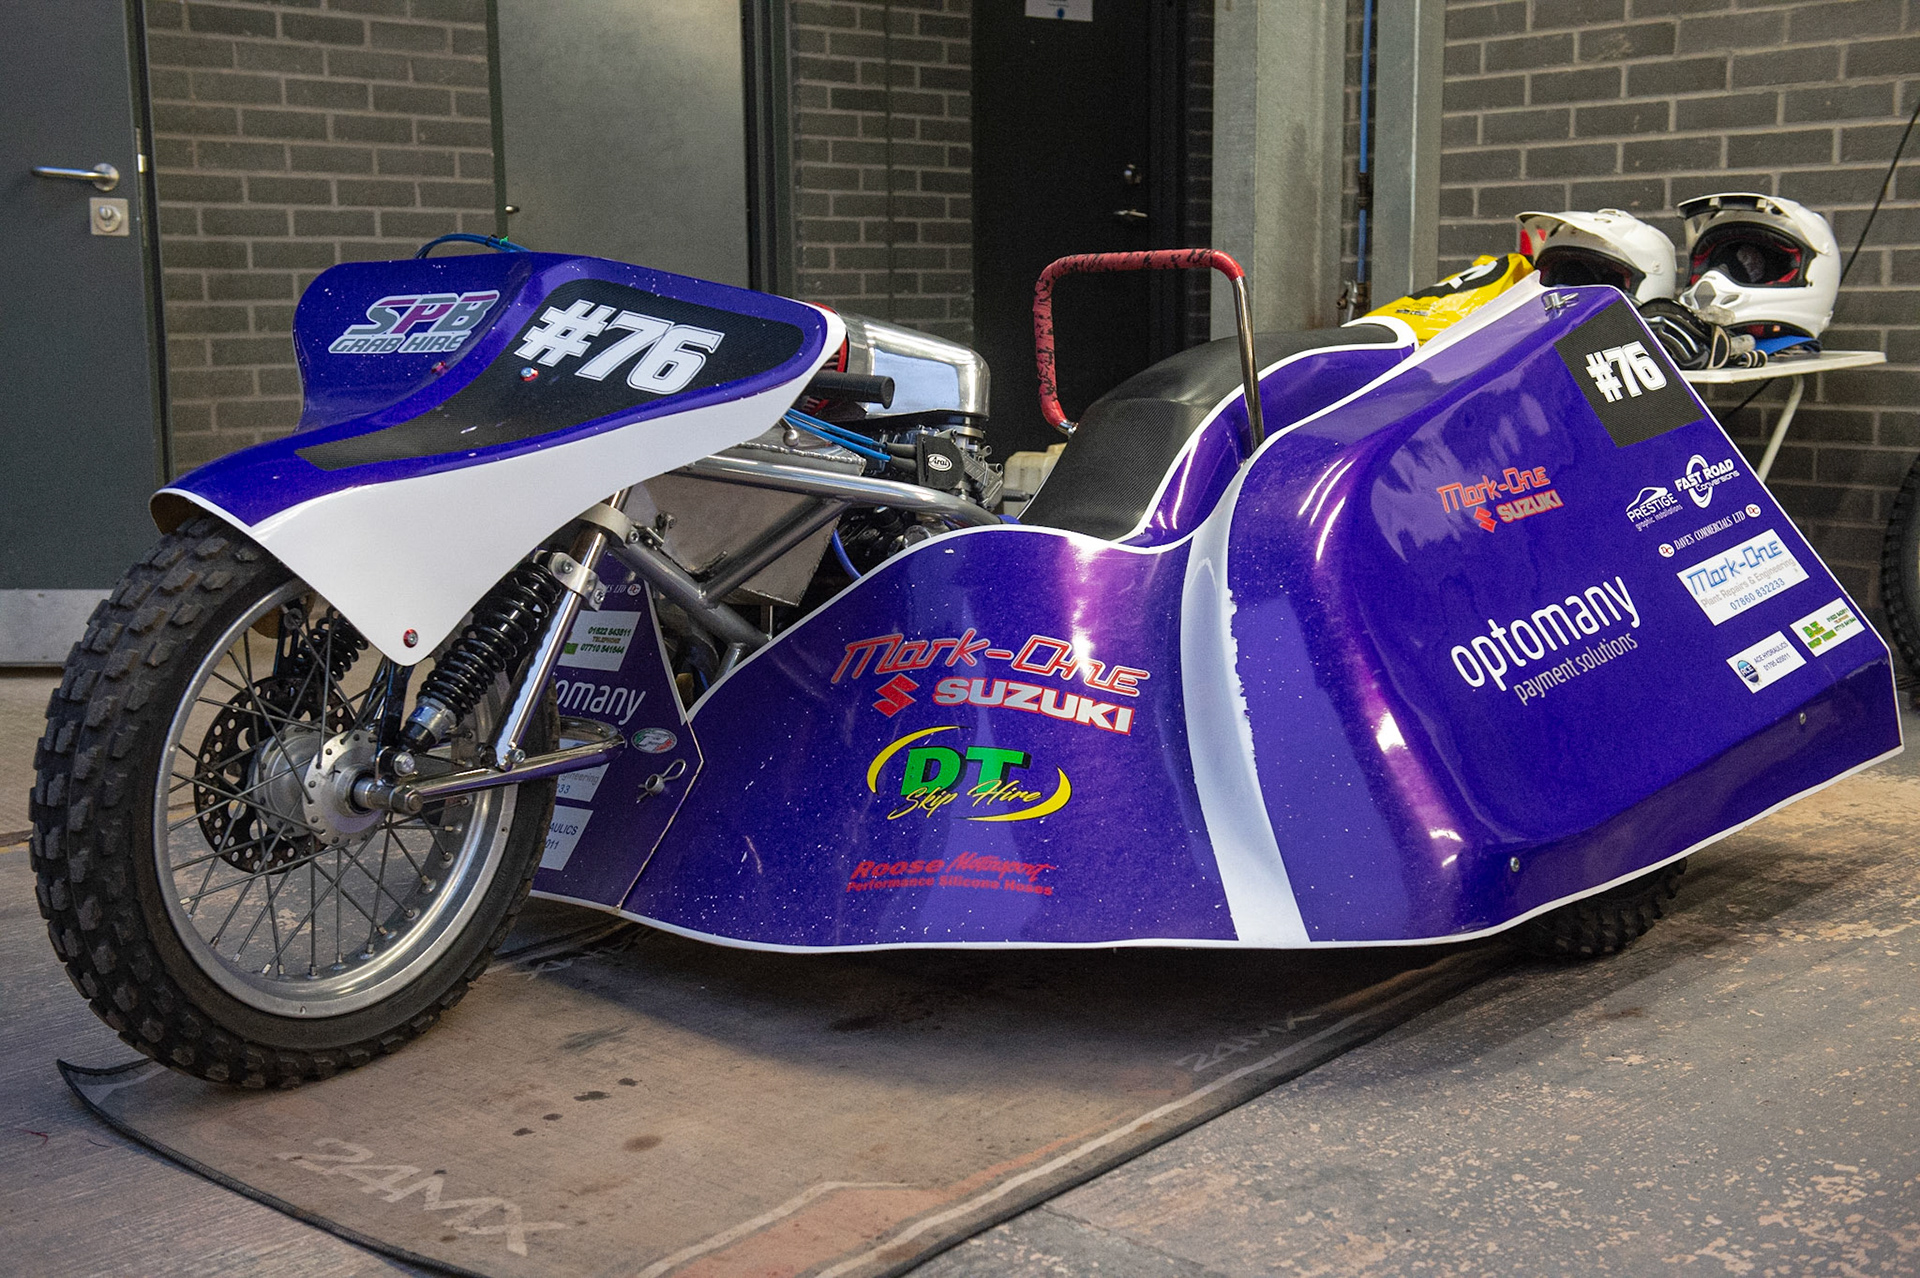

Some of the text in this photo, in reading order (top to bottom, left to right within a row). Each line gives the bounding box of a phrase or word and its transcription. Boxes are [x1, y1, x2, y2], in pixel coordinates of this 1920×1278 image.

[348, 291, 500, 335] SPB
[328, 333, 468, 354] GRAB HIRE
[514, 299, 725, 395] #76
[1585, 341, 1668, 403] #76
[1674, 458, 1734, 491] FAST ROAD
[1695, 470, 1740, 492] Conversions
[1496, 489, 1564, 523] SUZUKI
[1626, 493, 1678, 522] PRESTIGE
[1693, 516, 1734, 541] COMMERCIALS
[1731, 510, 1746, 524] LTD
[1701, 558, 1797, 608] Plant Repairs & Engineering
[1730, 578, 1785, 611] 07860 832233
[1451, 576, 1641, 692] optomany
[1513, 632, 1638, 706] payment solutions
[933, 677, 1135, 735] SUZUKI
[901, 746, 1030, 796] DT
[887, 779, 1043, 820] Skip Hire
[846, 875, 1053, 896] Performance Silicone Hoses
[850, 858, 945, 879] Roose
